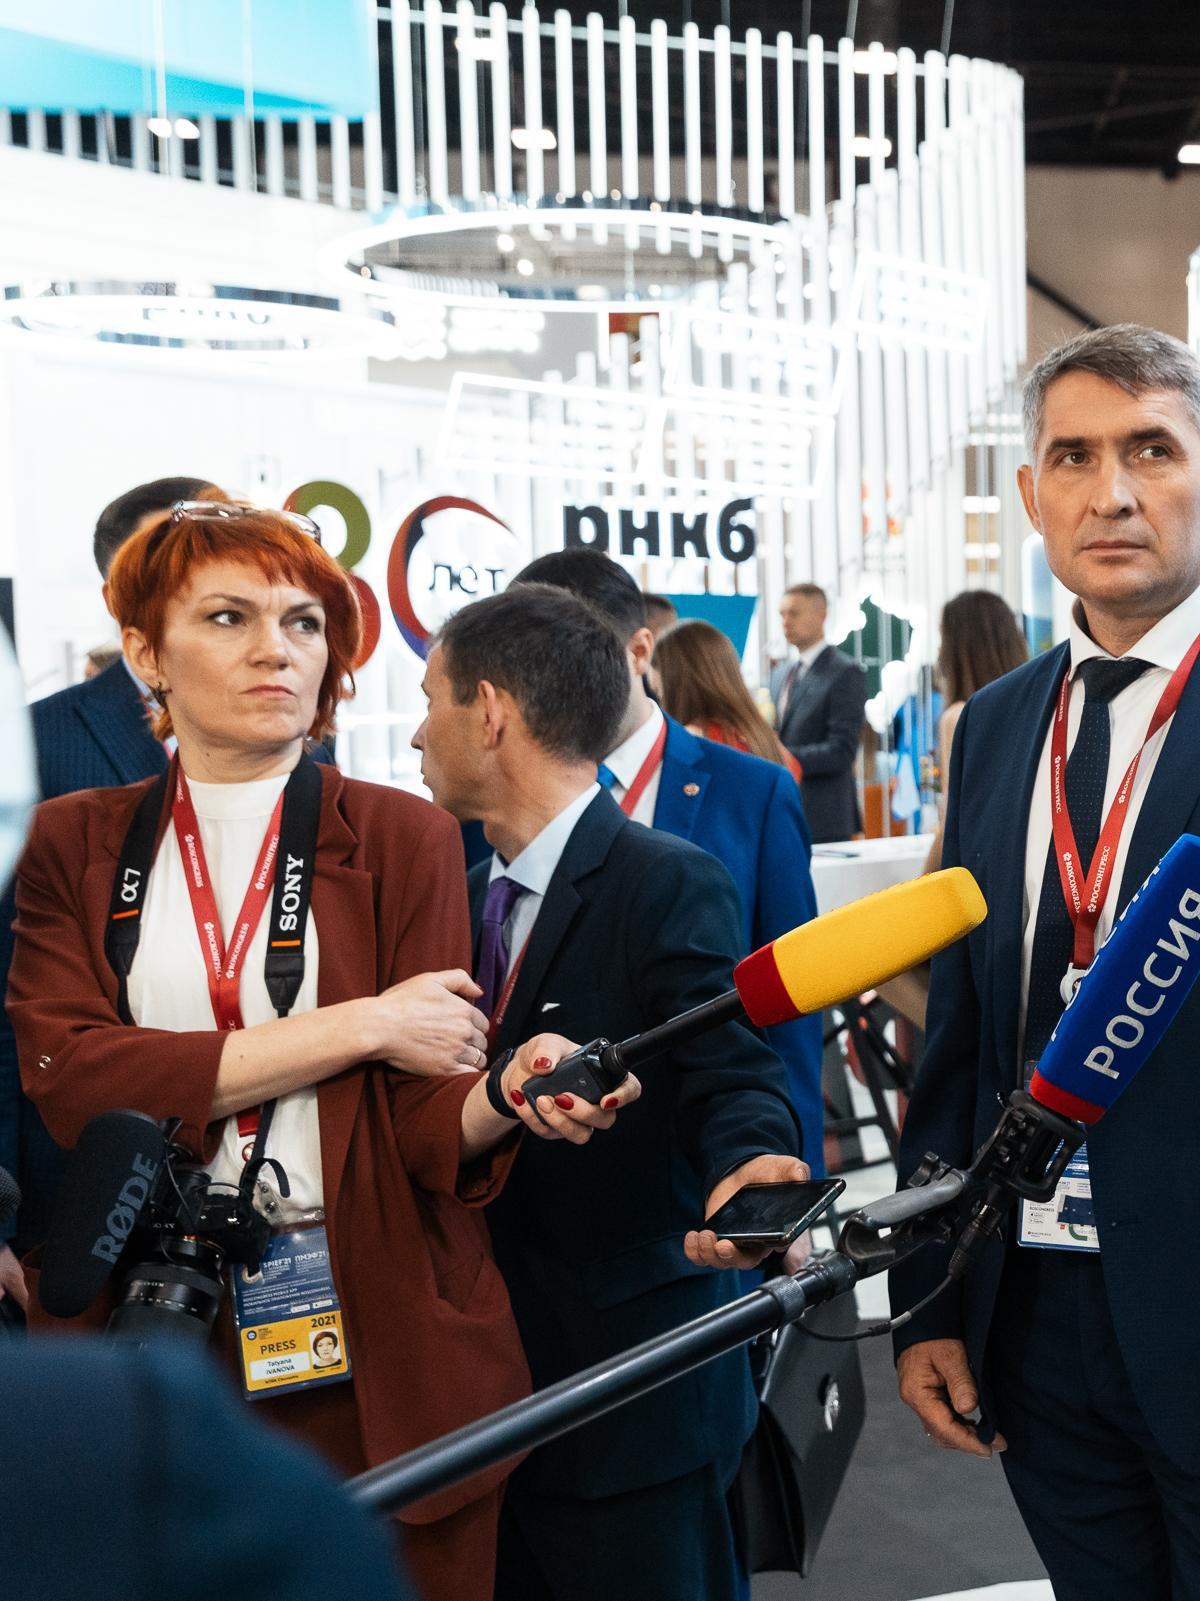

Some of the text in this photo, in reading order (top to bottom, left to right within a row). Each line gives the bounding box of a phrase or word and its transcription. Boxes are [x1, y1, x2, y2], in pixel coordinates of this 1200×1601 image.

[562, 498, 757, 562] рнкб
[428, 563, 506, 594] лет
[1090, 845, 1111, 904] РОСКОНГРЕСС
[279, 853, 304, 930] SONY
[91, 1153, 158, 1264] RØDE
[311, 1314, 336, 1329] 2021
[260, 1339, 297, 1356] PRESS
[267, 1358, 292, 1368] Tatyana
[266, 1365, 295, 1376] IVANOVA
